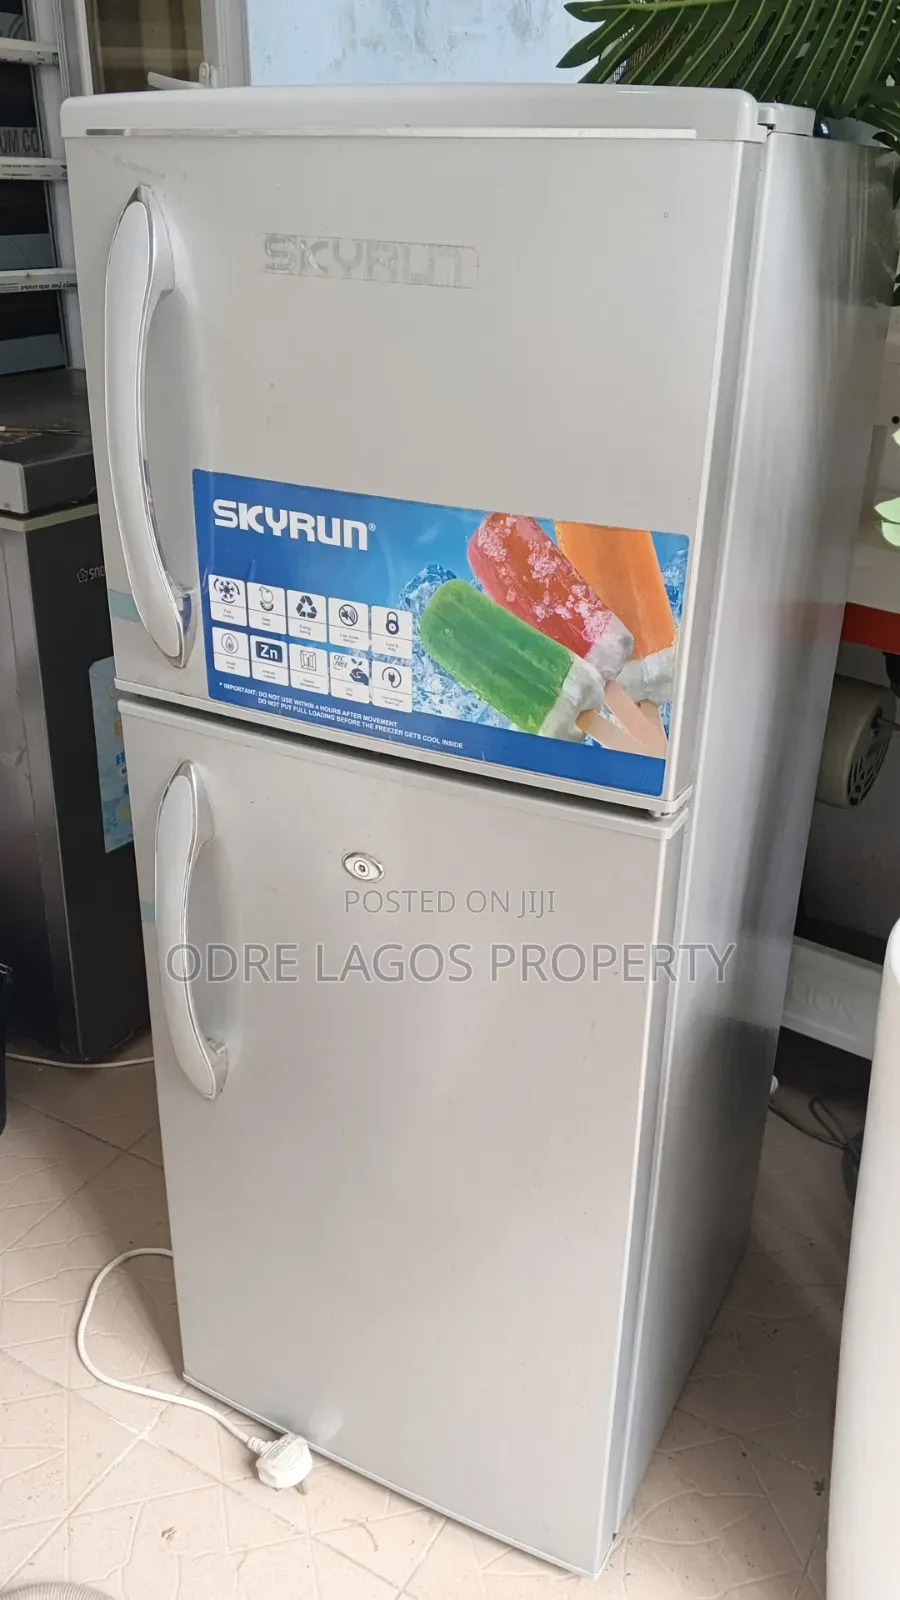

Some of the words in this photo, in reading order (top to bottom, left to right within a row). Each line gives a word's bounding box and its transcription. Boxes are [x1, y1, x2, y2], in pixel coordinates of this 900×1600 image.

[264, 233, 462, 287] SKYRUN
[260, 644, 279, 660] Zn
[223, 682, 258, 697] IMPORTANT:
[268, 693, 280, 701] NOT
[281, 696, 293, 704] USE
[293, 699, 315, 709] WITHIN
[319, 705, 341, 715] HOURS
[341, 710, 362, 719] AFTER
[362, 714, 398, 727] MOVEMENT
[281, 703, 292, 711] PUT
[293, 705, 308, 714] FULL
[308, 709, 335, 721] LOADING
[336, 716, 361, 727] BEFORE
[362, 721, 374, 730] THE
[375, 723, 403, 736] FREEZER
[404, 731, 421, 740] GETS
[422, 734, 440, 745] COOL
[441, 739, 463, 749] INSIDE
